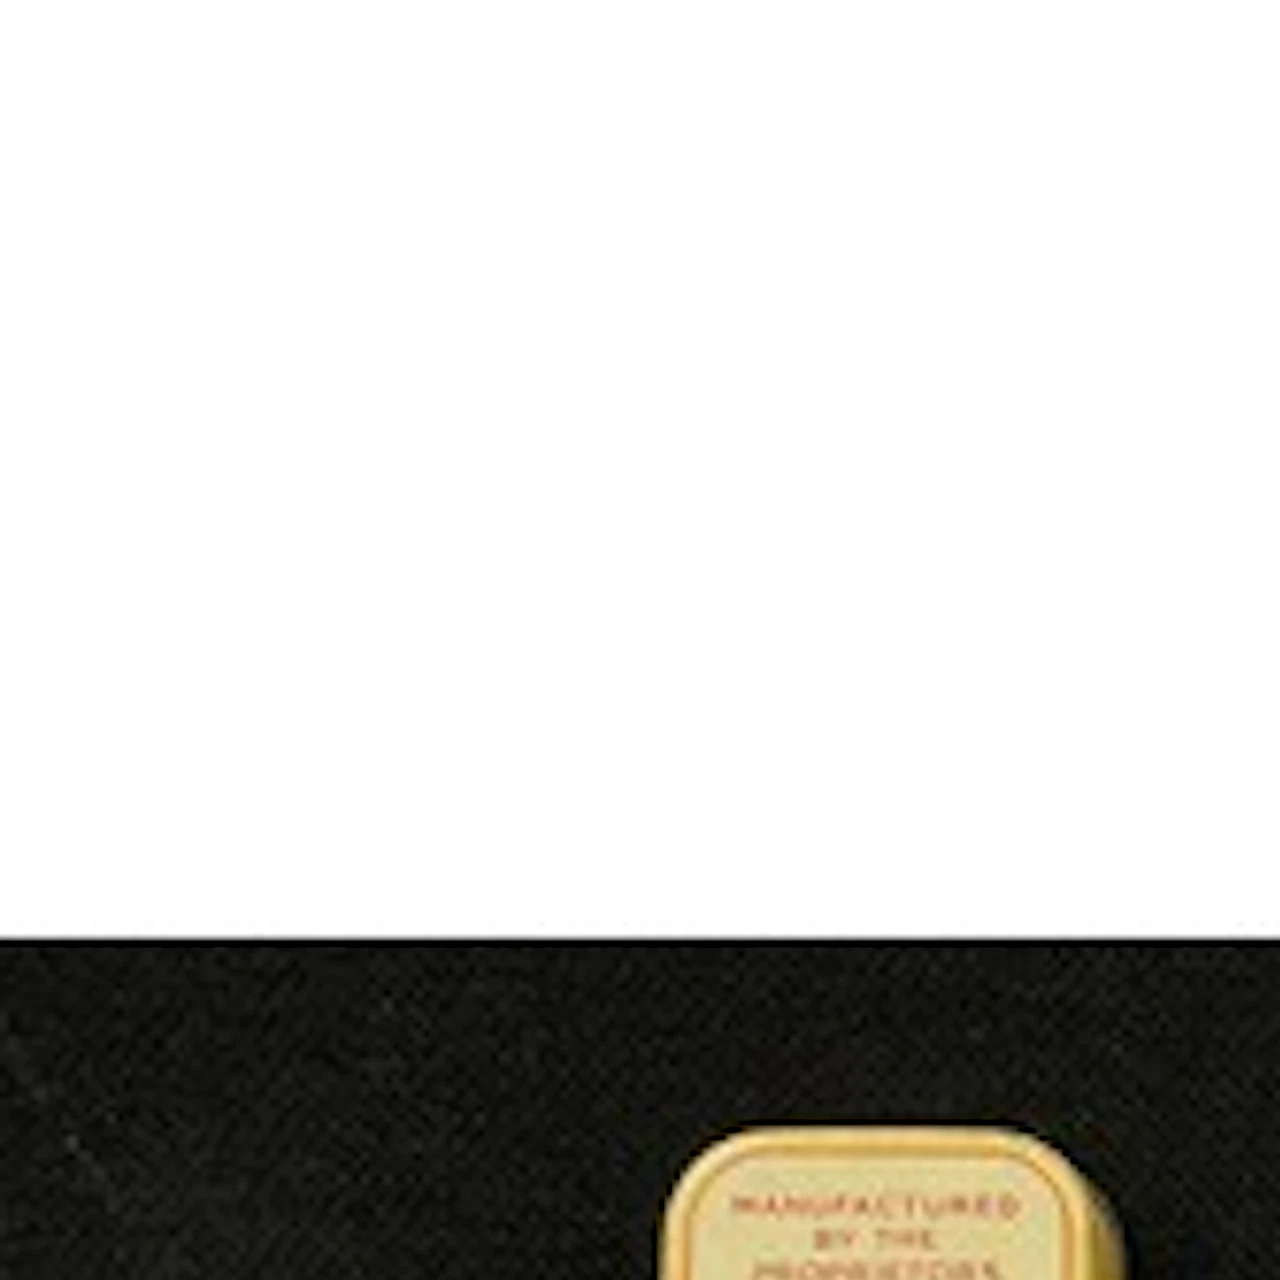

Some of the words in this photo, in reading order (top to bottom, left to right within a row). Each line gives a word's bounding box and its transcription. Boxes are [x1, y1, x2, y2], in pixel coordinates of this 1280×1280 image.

[731, 1193, 1022, 1217] MANUFACTURED
[813, 1229, 857, 1251] BY
[876, 1229, 938, 1251] THE
